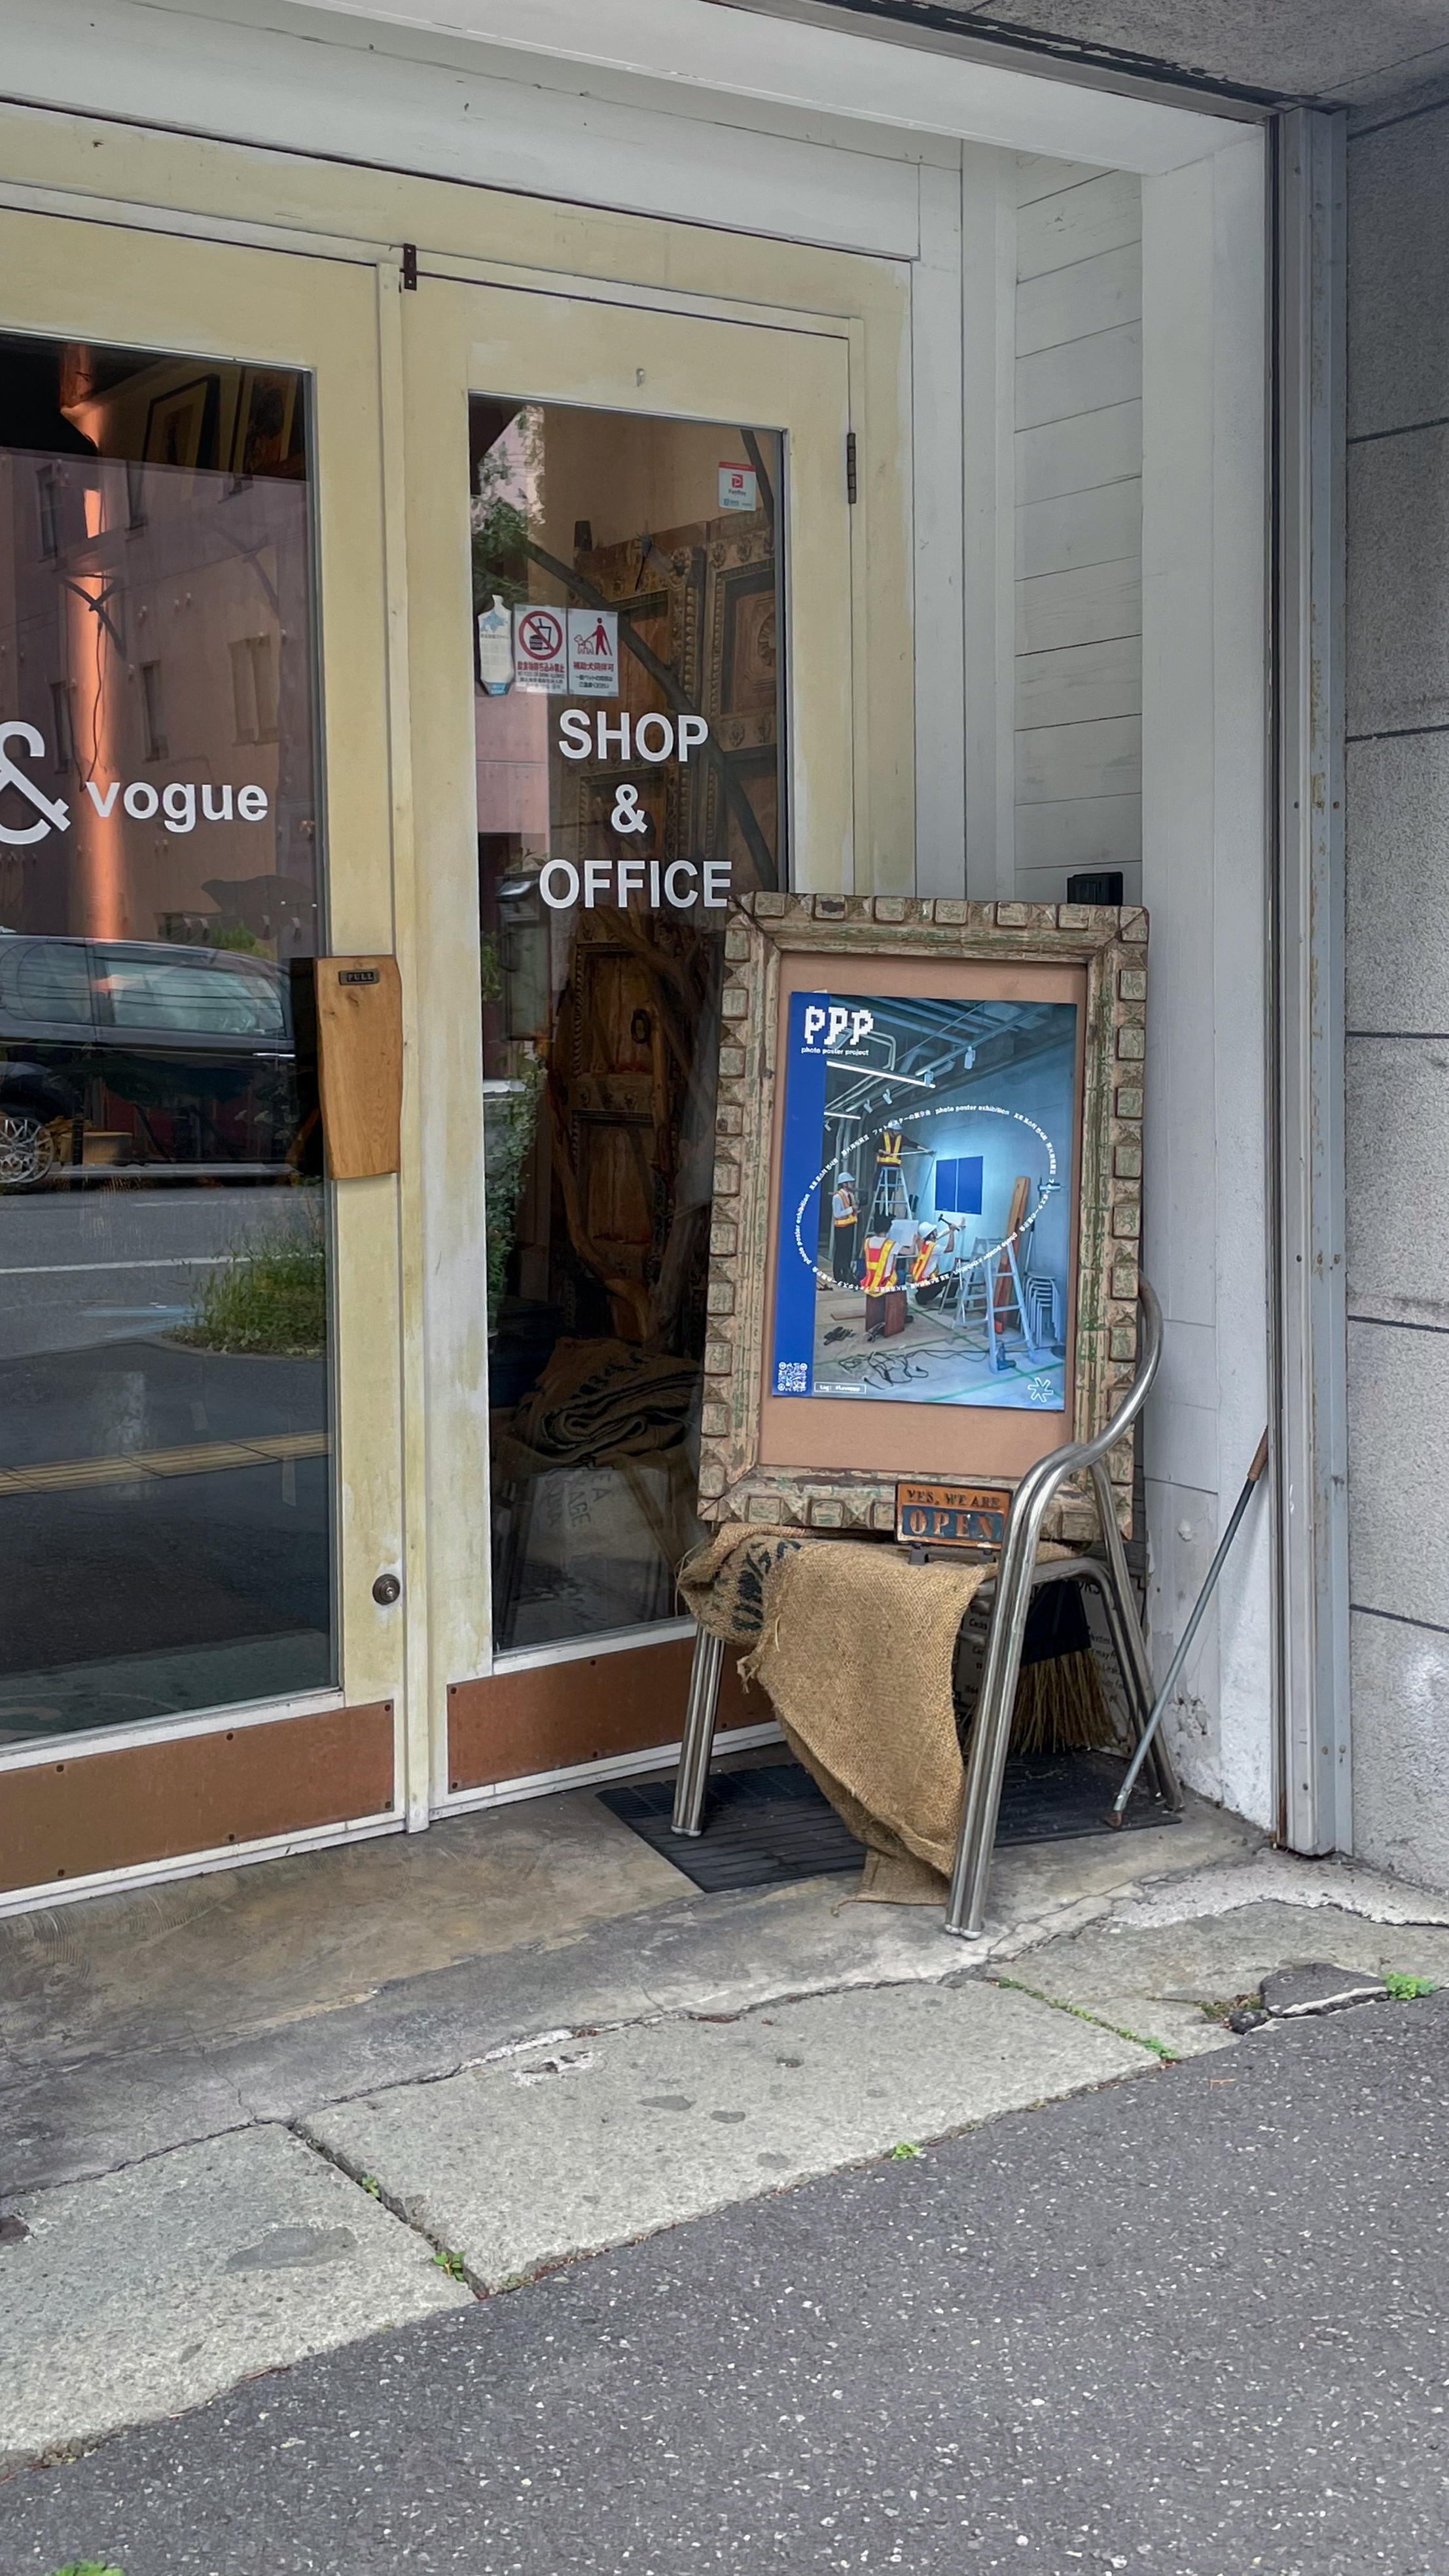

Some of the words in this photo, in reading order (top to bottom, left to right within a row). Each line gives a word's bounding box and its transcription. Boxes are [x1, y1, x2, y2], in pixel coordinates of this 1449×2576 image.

[573, 662, 614, 671] 補助犬同伴可
[558, 709, 709, 762] SHOP
[86, 779, 269, 834] vogue
[610, 783, 648, 834] &
[539, 859, 732, 909] OFFICE
[348, 973, 374, 981] PULL
[935, 1106, 954, 1115] photo
[978, 1105, 1009, 1115] exhibition
[794, 1225, 803, 1246] poster
[798, 1247, 812, 1264] photo
[907, 1489, 940, 1505] YES,
[944, 1493, 967, 1505] WE
[971, 1495, 1000, 1508] ARE
[910, 1509, 995, 1539] OPEN
